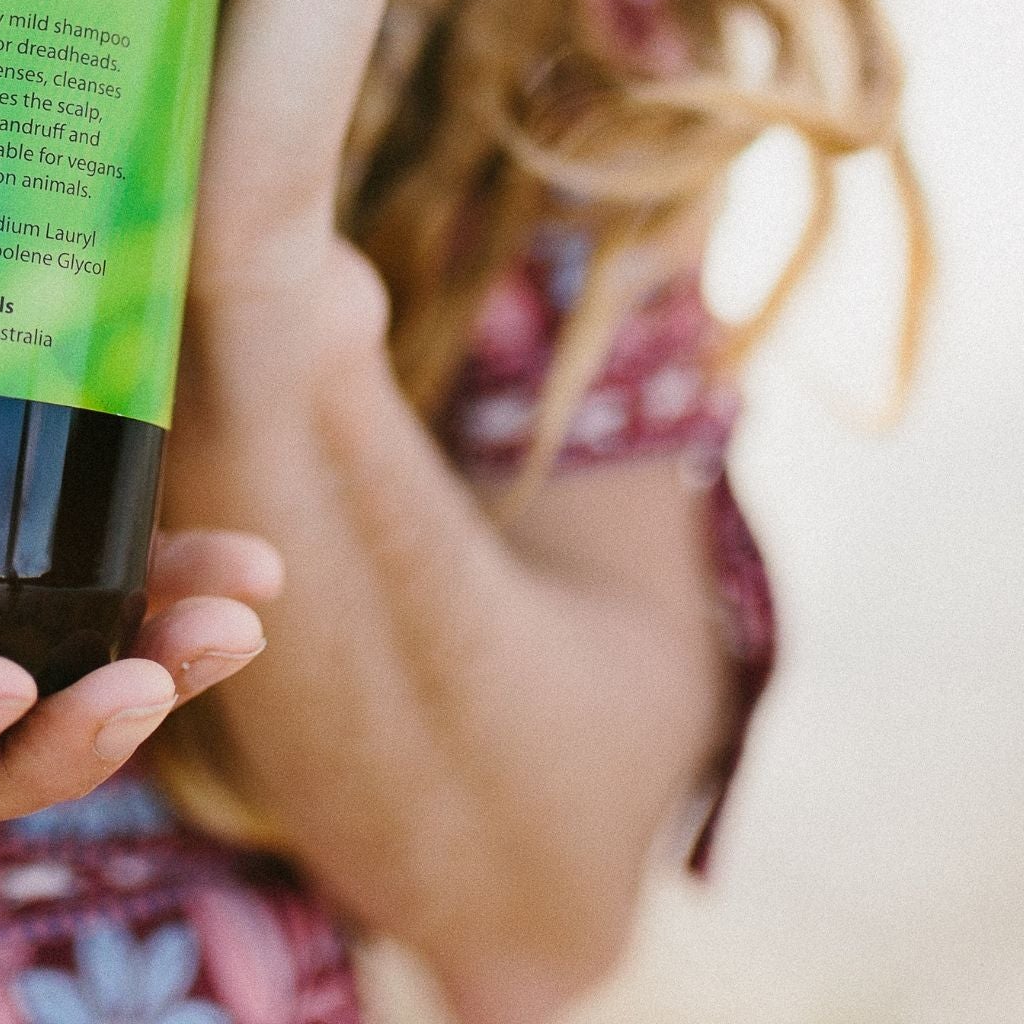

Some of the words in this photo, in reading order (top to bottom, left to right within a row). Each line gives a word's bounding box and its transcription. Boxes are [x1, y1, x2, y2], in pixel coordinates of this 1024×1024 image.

[9, 13, 48, 32] mild
[54, 19, 131, 48] shampoo
[17, 39, 121, 72] dreadheads.
[53, 72, 122, 99] cleanses
[23, 92, 52, 111] the
[57, 100, 103, 123] scalp,
[69, 130, 100, 147] and
[39, 147, 63, 166] for
[68, 154, 126, 180] vegans.
[22, 174, 92, 199] animals.
[45, 223, 96, 250] Lauryl
[57, 252, 107, 276] Glycol
